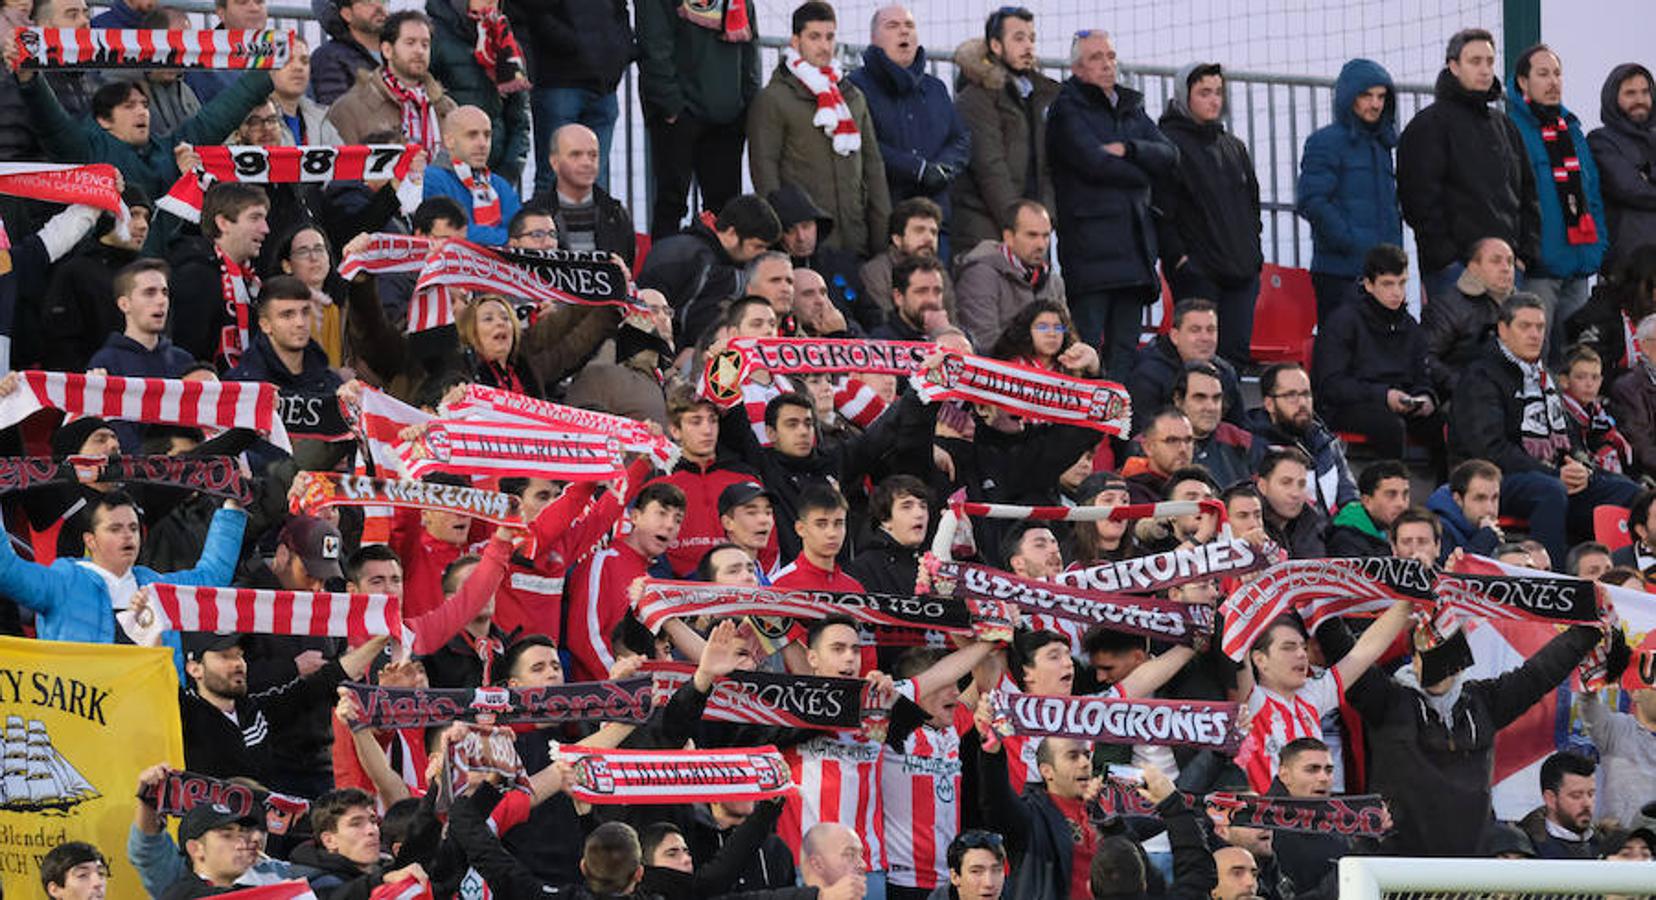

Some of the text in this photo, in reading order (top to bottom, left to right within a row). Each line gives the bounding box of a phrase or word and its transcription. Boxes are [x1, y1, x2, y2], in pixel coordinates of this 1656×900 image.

[341, 474, 376, 499] LA
[31, 671, 108, 726] SARK
[350, 689, 457, 722] Viejo
